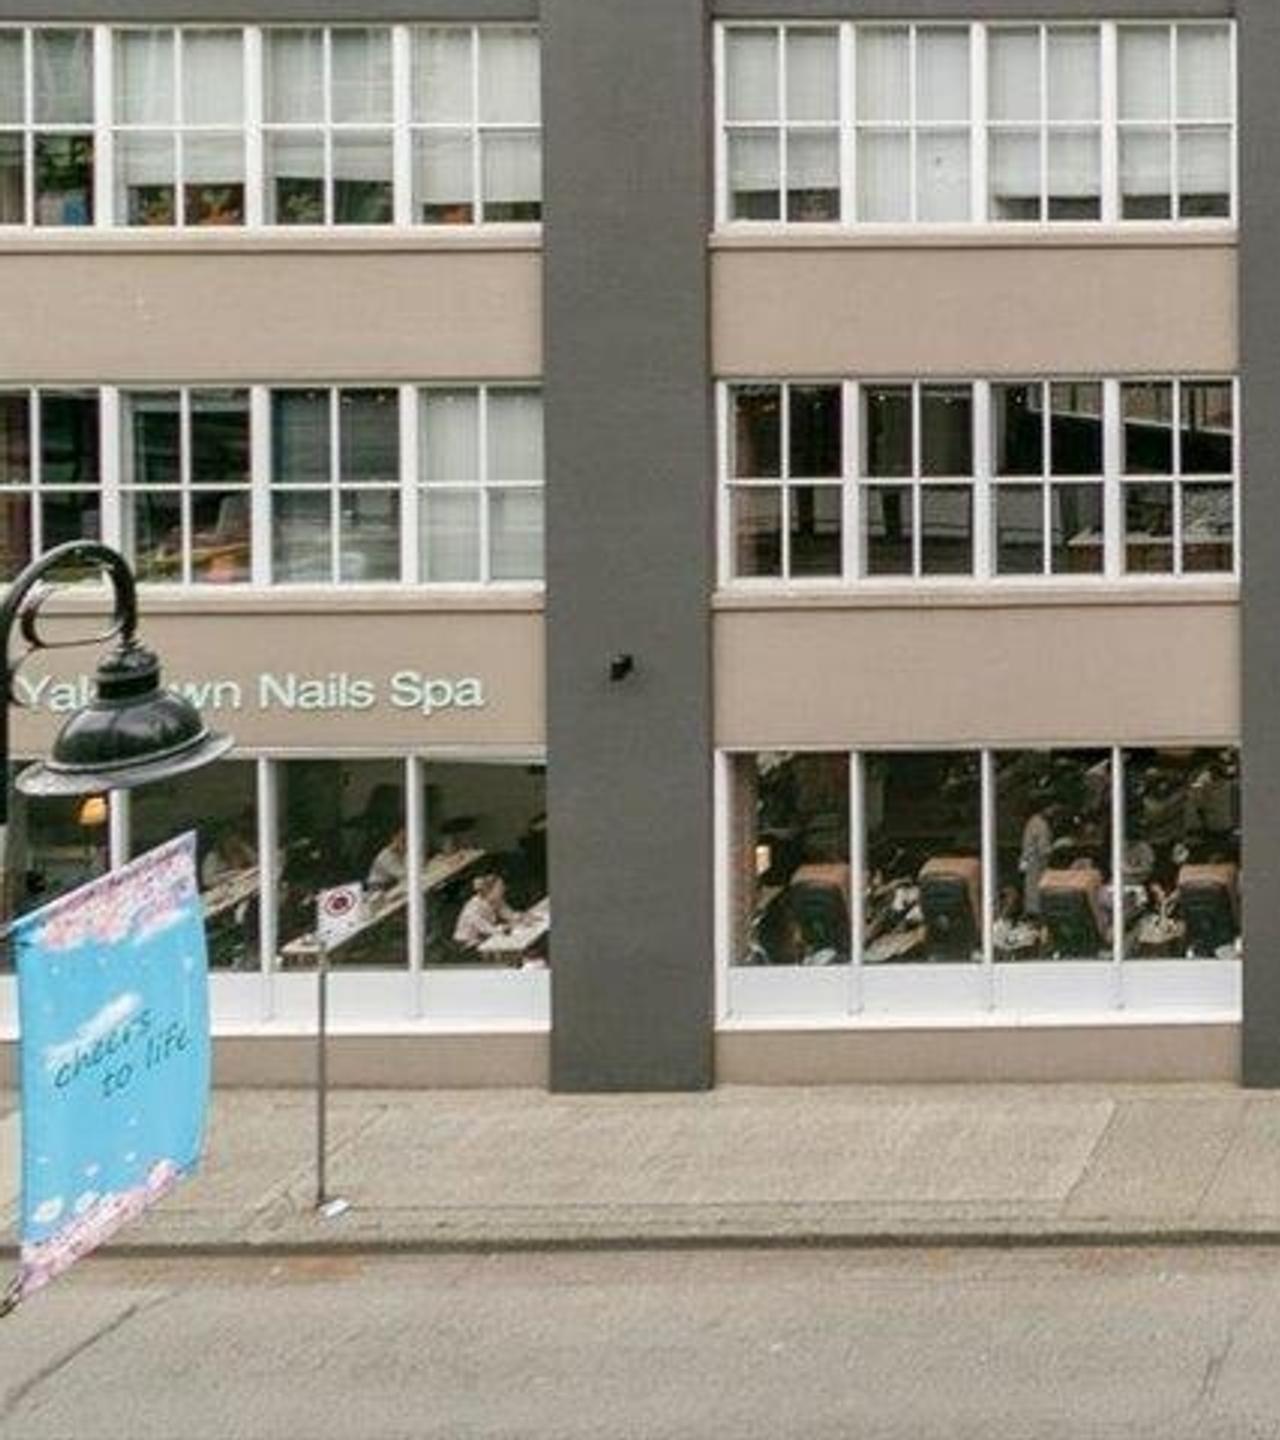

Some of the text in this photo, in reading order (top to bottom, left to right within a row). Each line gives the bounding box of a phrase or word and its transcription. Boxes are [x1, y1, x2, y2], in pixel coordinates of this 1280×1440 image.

[14, 671, 485, 716] Yalwn Nails Spa
[53, 1008, 152, 1088] cheers
[101, 1021, 189, 1097] to life
